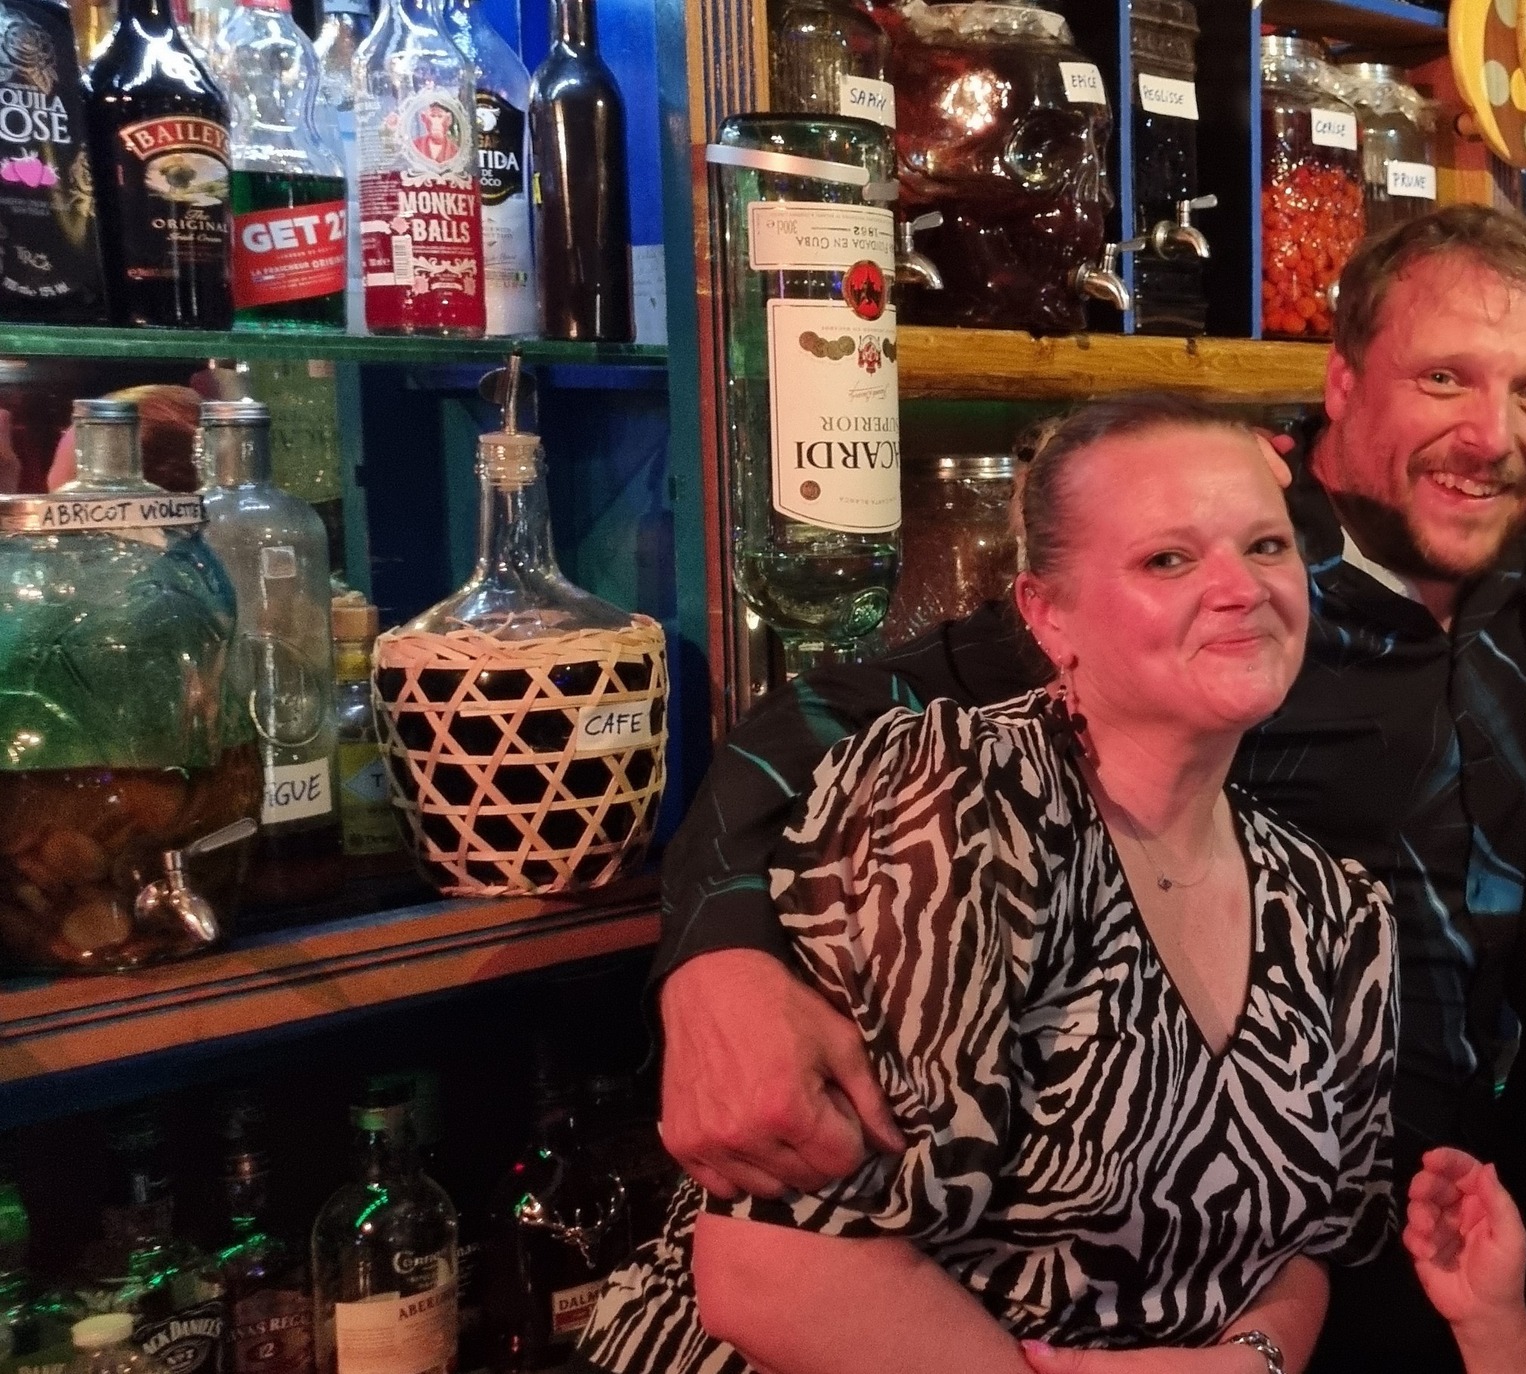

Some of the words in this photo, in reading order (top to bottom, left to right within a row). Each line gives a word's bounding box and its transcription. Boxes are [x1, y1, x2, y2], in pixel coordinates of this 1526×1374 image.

[0, 88, 66, 114] QUILA
[0, 106, 71, 143] OSE
[478, 150, 520, 171] TIDA
[480, 177, 502, 187] OCO
[400, 191, 476, 220] MONKEY
[152, 218, 228, 233] ORIGINAL
[242, 215, 321, 254] GET
[412, 218, 470, 243] BALLS
[796, 236, 830, 249] CUBA
[794, 440, 900, 469] ACARDI
[585, 712, 643, 735] CAFE
